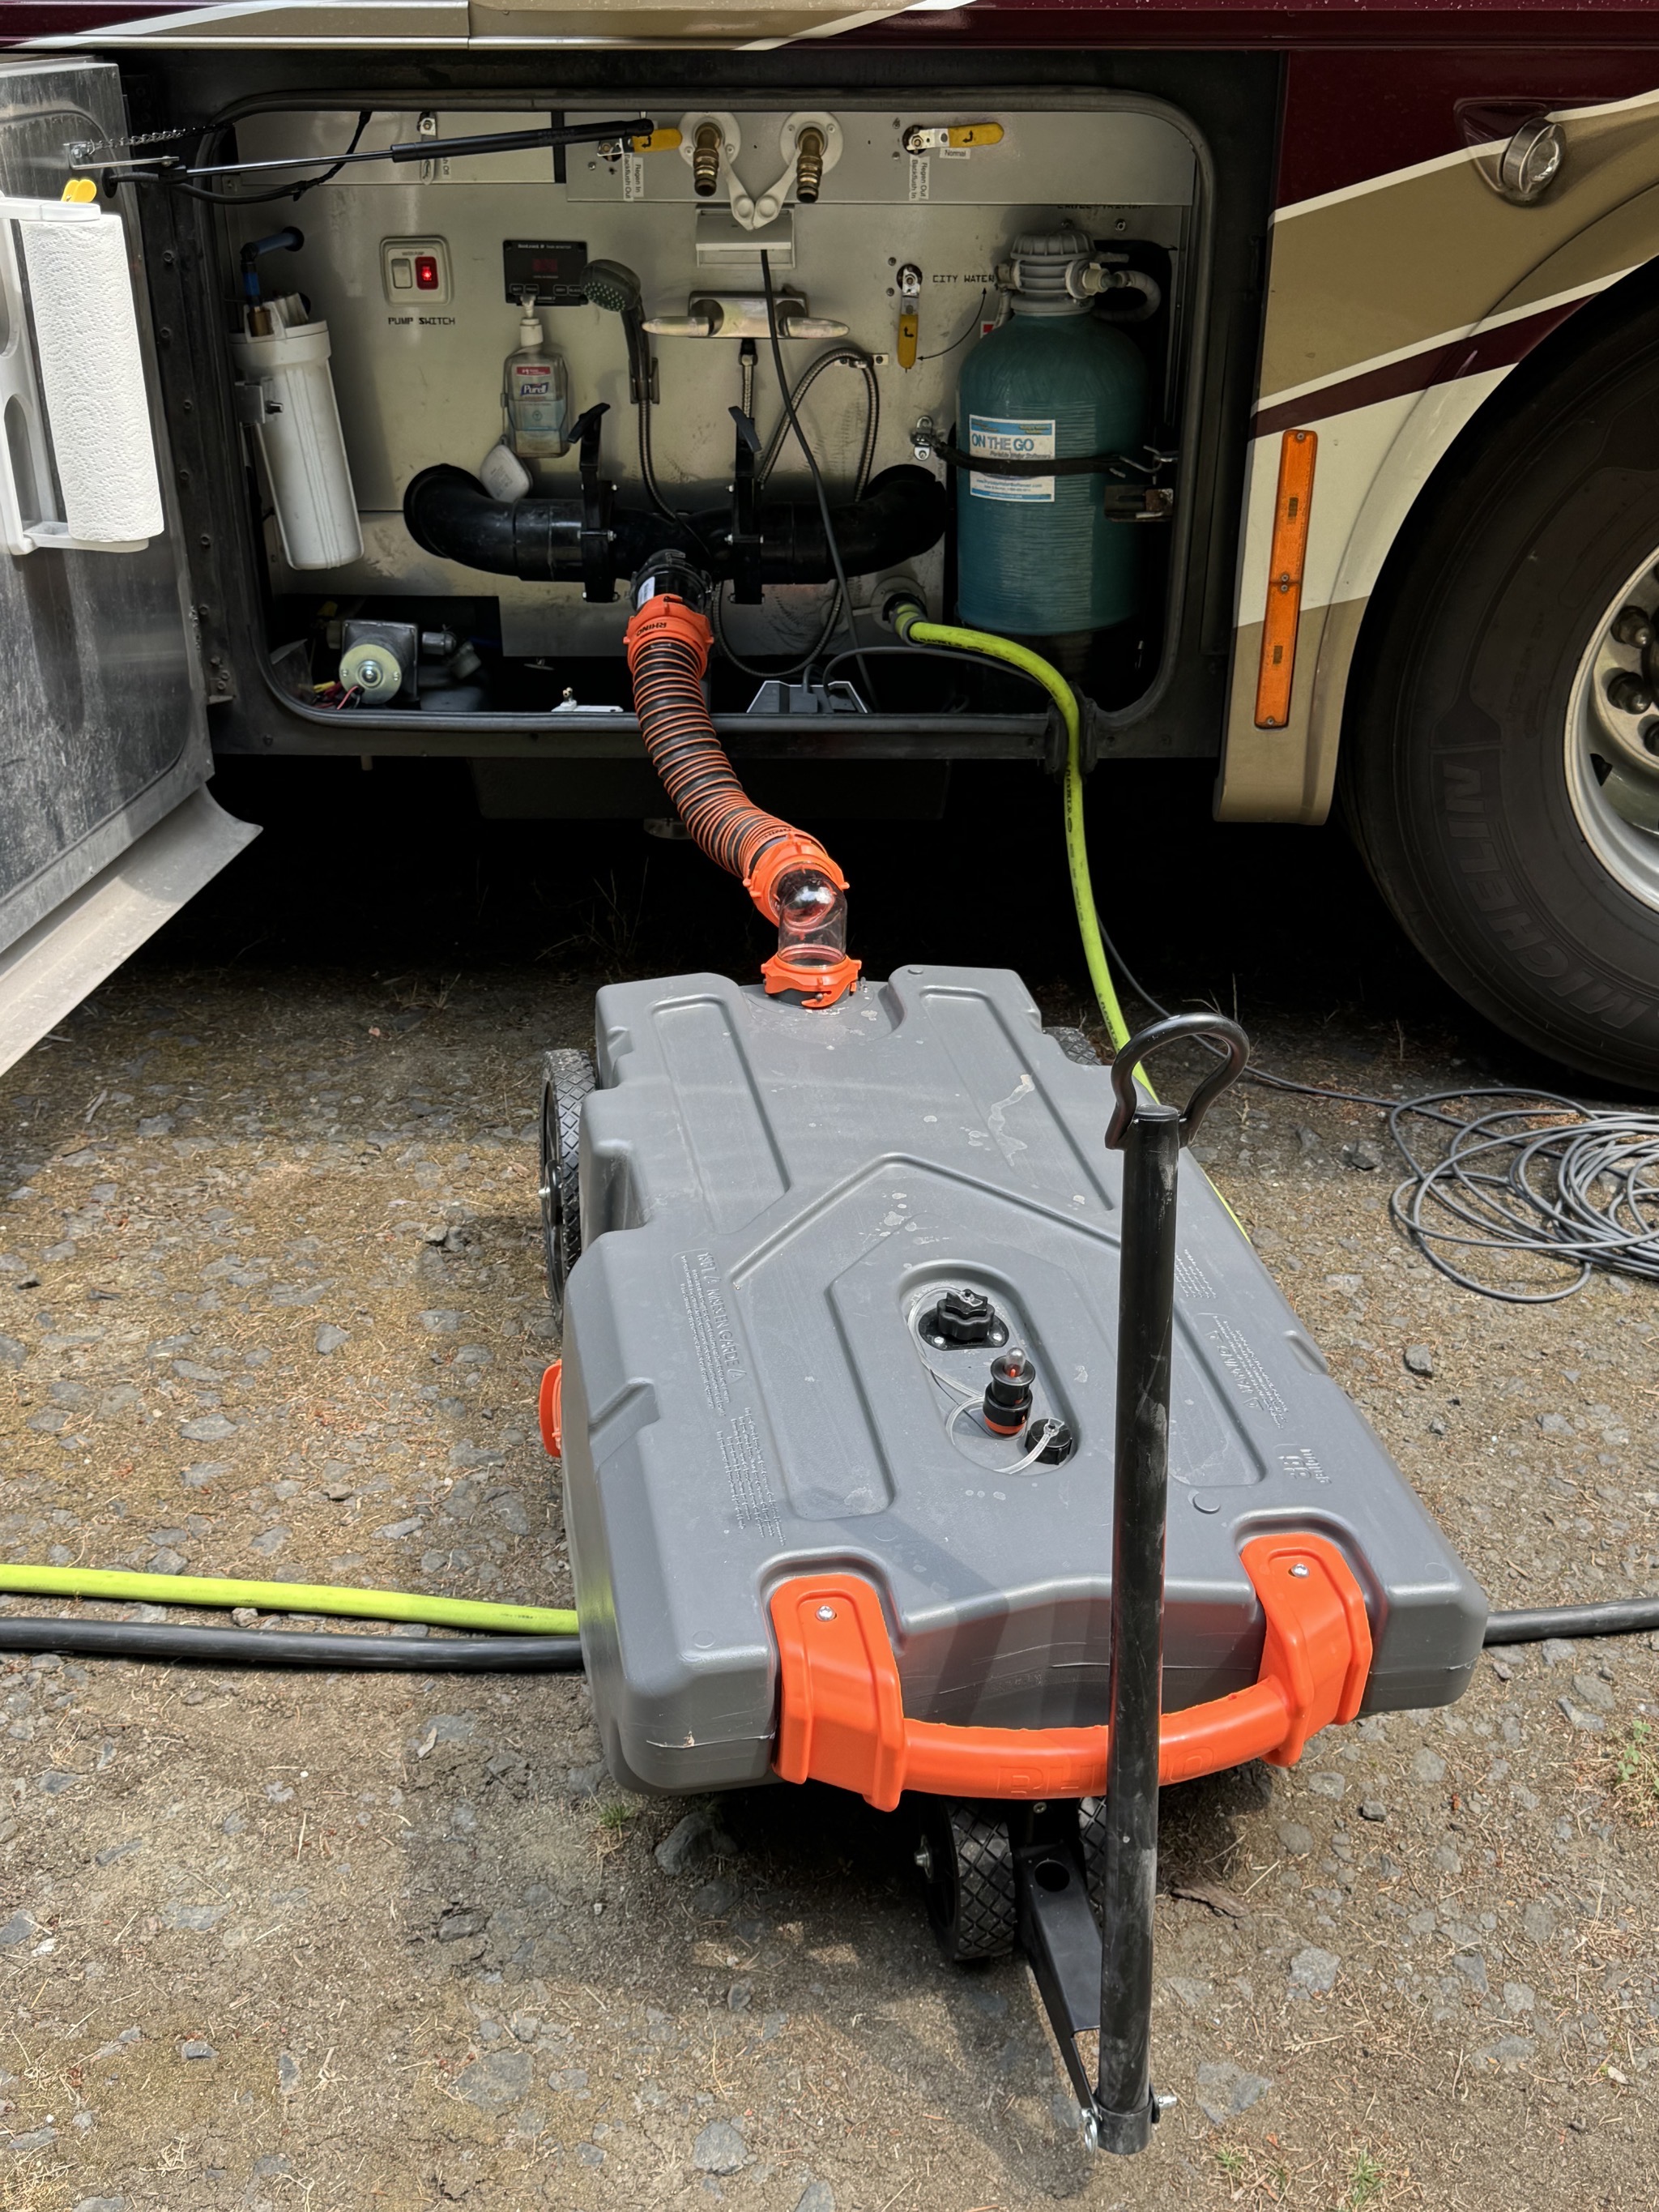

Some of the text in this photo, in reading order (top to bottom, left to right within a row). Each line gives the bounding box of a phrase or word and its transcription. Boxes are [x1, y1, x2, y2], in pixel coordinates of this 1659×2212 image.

[945, 149, 966, 157] Normal
[932, 275, 995, 283] CITY WATER
[388, 317, 455, 325] PUMP SWITCH
[971, 433, 1034, 452] ON THE GO
[636, 621, 667, 637] RHINO
[1443, 758, 1653, 1029] MICHELIN
